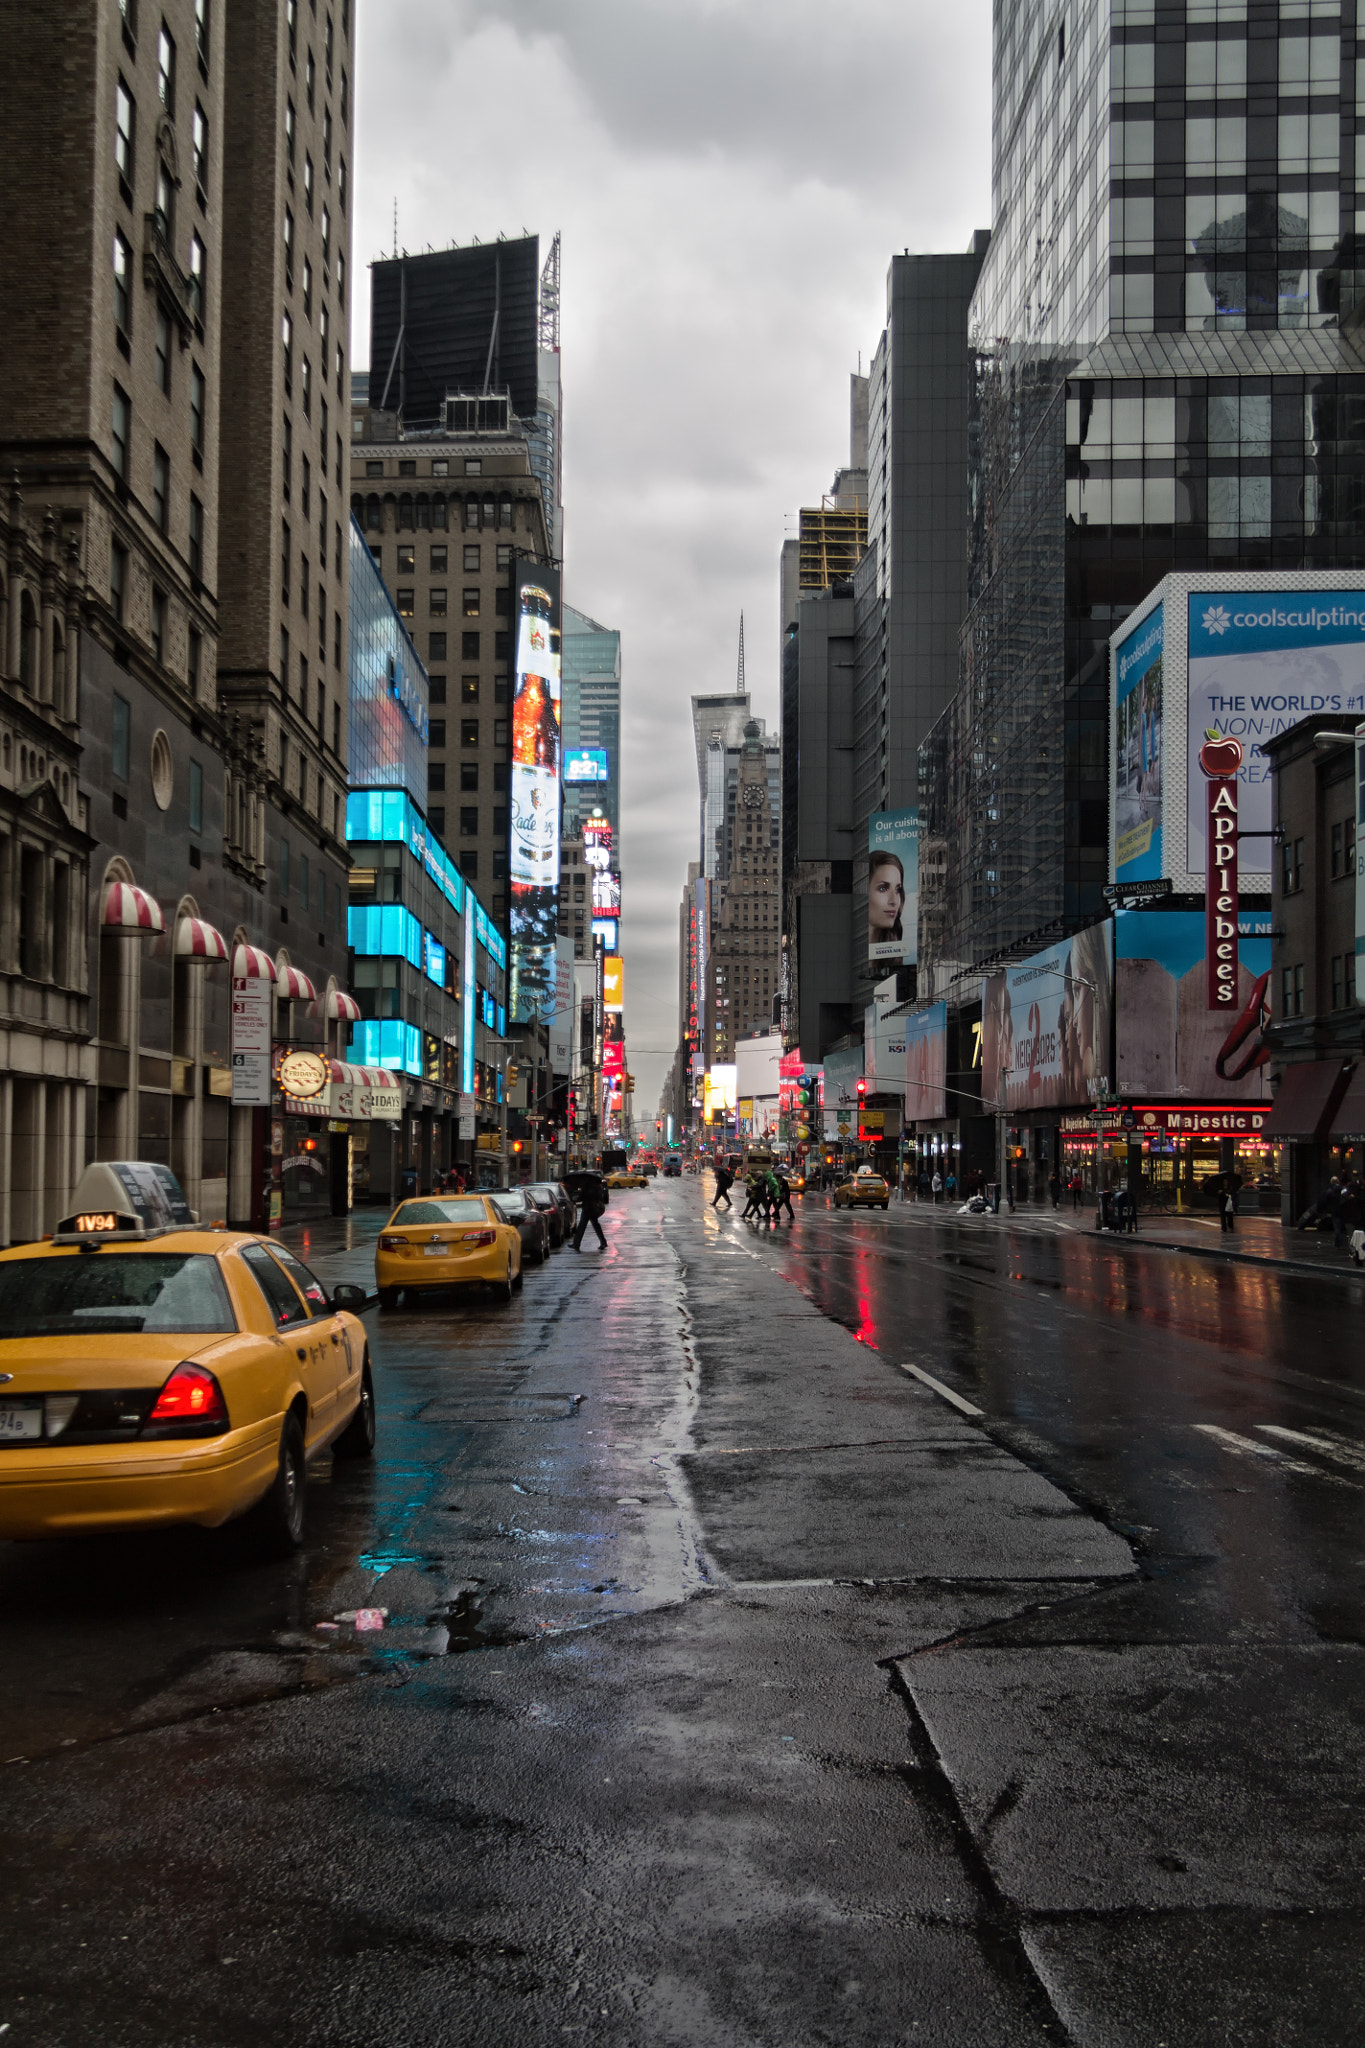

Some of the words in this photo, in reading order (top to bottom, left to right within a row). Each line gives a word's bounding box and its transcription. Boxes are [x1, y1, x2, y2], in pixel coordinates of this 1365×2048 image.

[1208, 696, 1245, 711] THE
[1250, 695, 1341, 711] WORLD'S
[1347, 695, 1364, 710] #1
[570, 760, 598, 774] 8:21
[875, 821, 893, 831] Our
[894, 816, 919, 828] cuisin
[875, 834, 882, 843] is
[884, 831, 894, 842] all
[1211, 787, 1238, 1002] Applebee's
[236, 1003, 243, 1013] 3
[235, 1056, 242, 1065] 6
[1168, 1114, 1246, 1130] Majestic
[76, 1214, 116, 1232] 1V94
